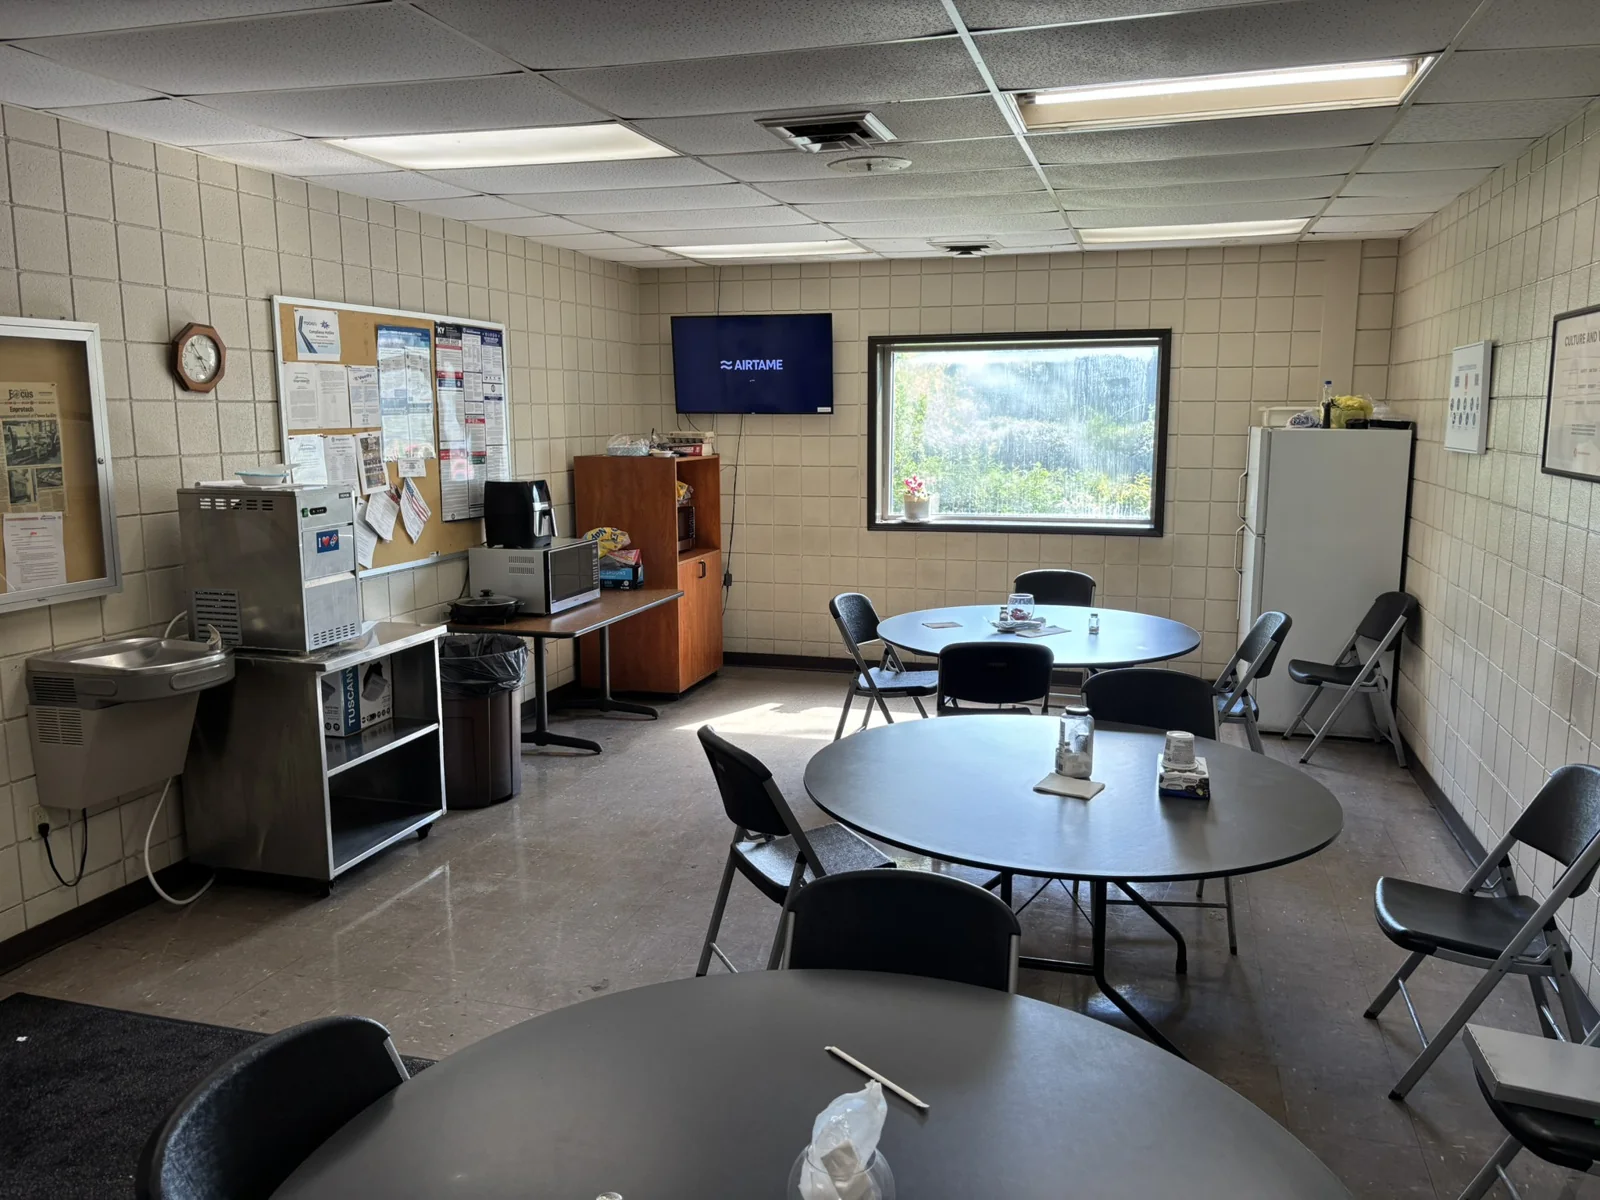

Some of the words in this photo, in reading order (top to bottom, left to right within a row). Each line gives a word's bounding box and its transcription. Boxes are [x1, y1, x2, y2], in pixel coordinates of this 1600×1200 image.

[437, 326, 445, 334] KY
[1565, 333, 1586, 347] CULTURE
[1586, 331, 1598, 343] AND
[734, 360, 783, 370] AIRTAME
